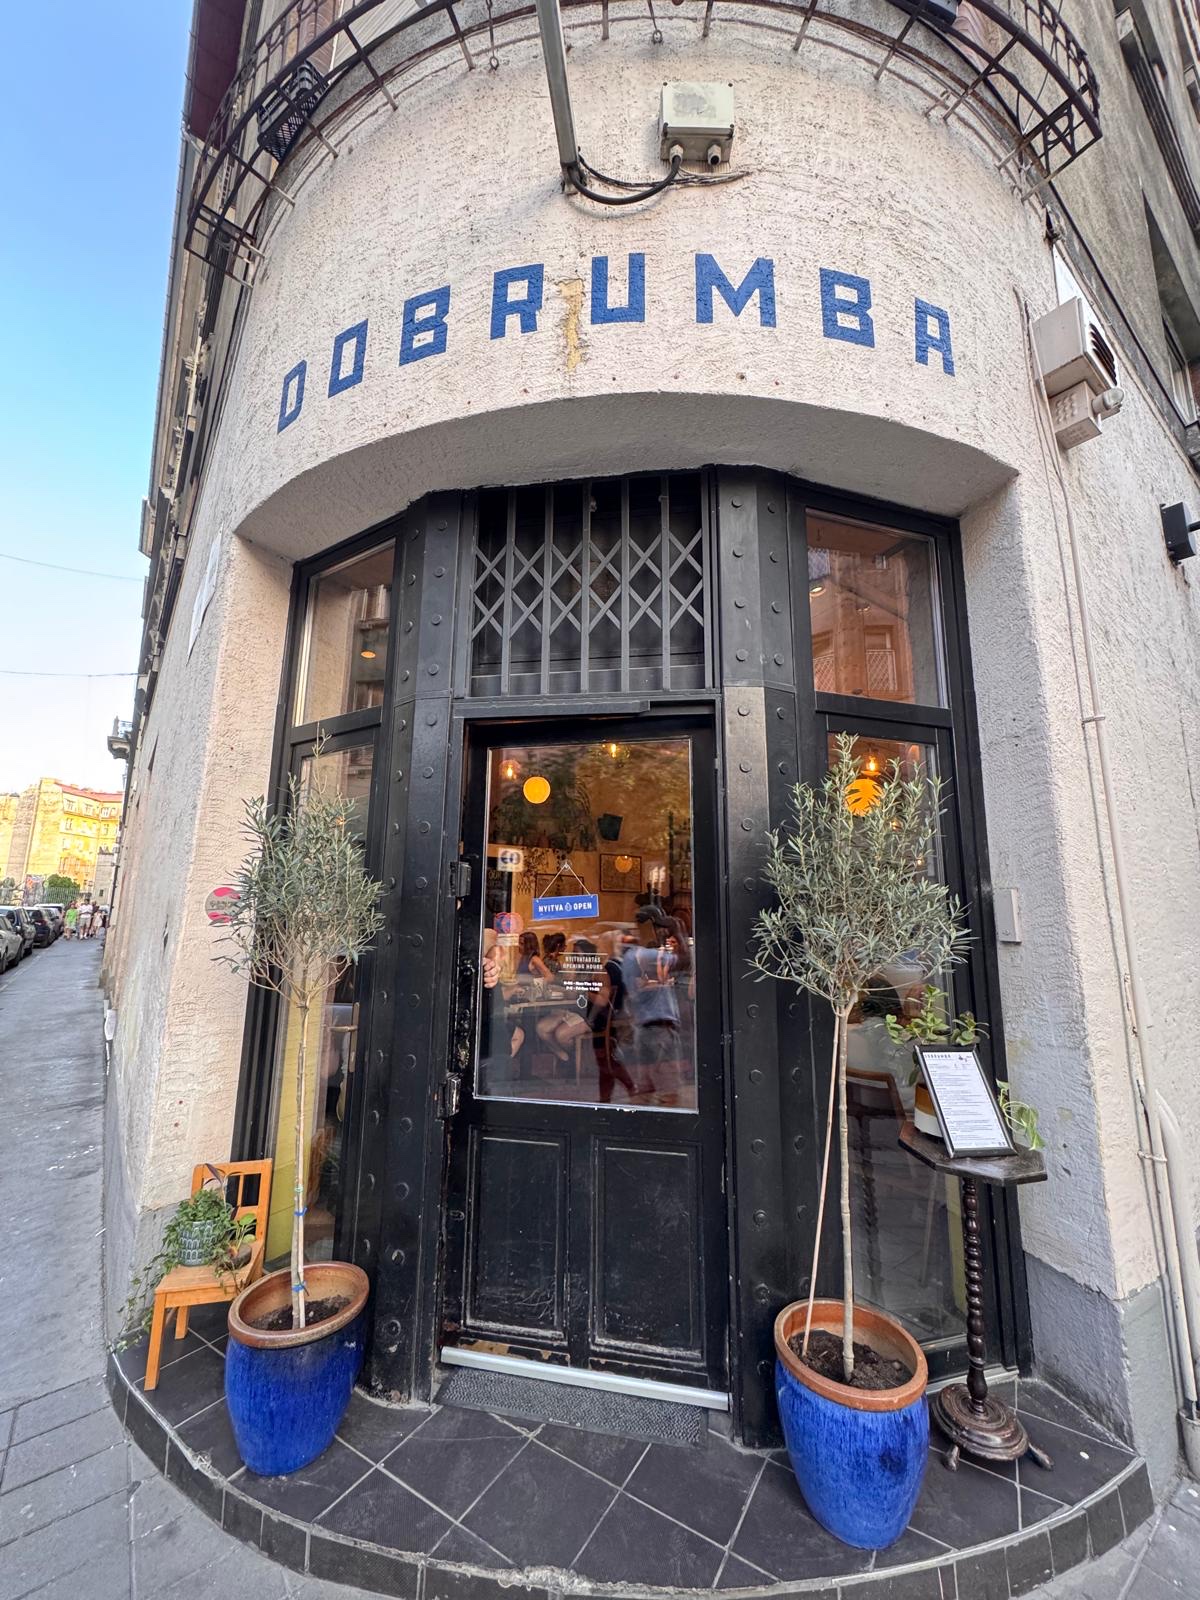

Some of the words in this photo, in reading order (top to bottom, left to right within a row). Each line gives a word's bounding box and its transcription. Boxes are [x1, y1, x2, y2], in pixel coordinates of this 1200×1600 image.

[277, 253, 955, 434] DOBRUMBA
[538, 903, 564, 912] NYITVA
[573, 902, 593, 910] OPEN
